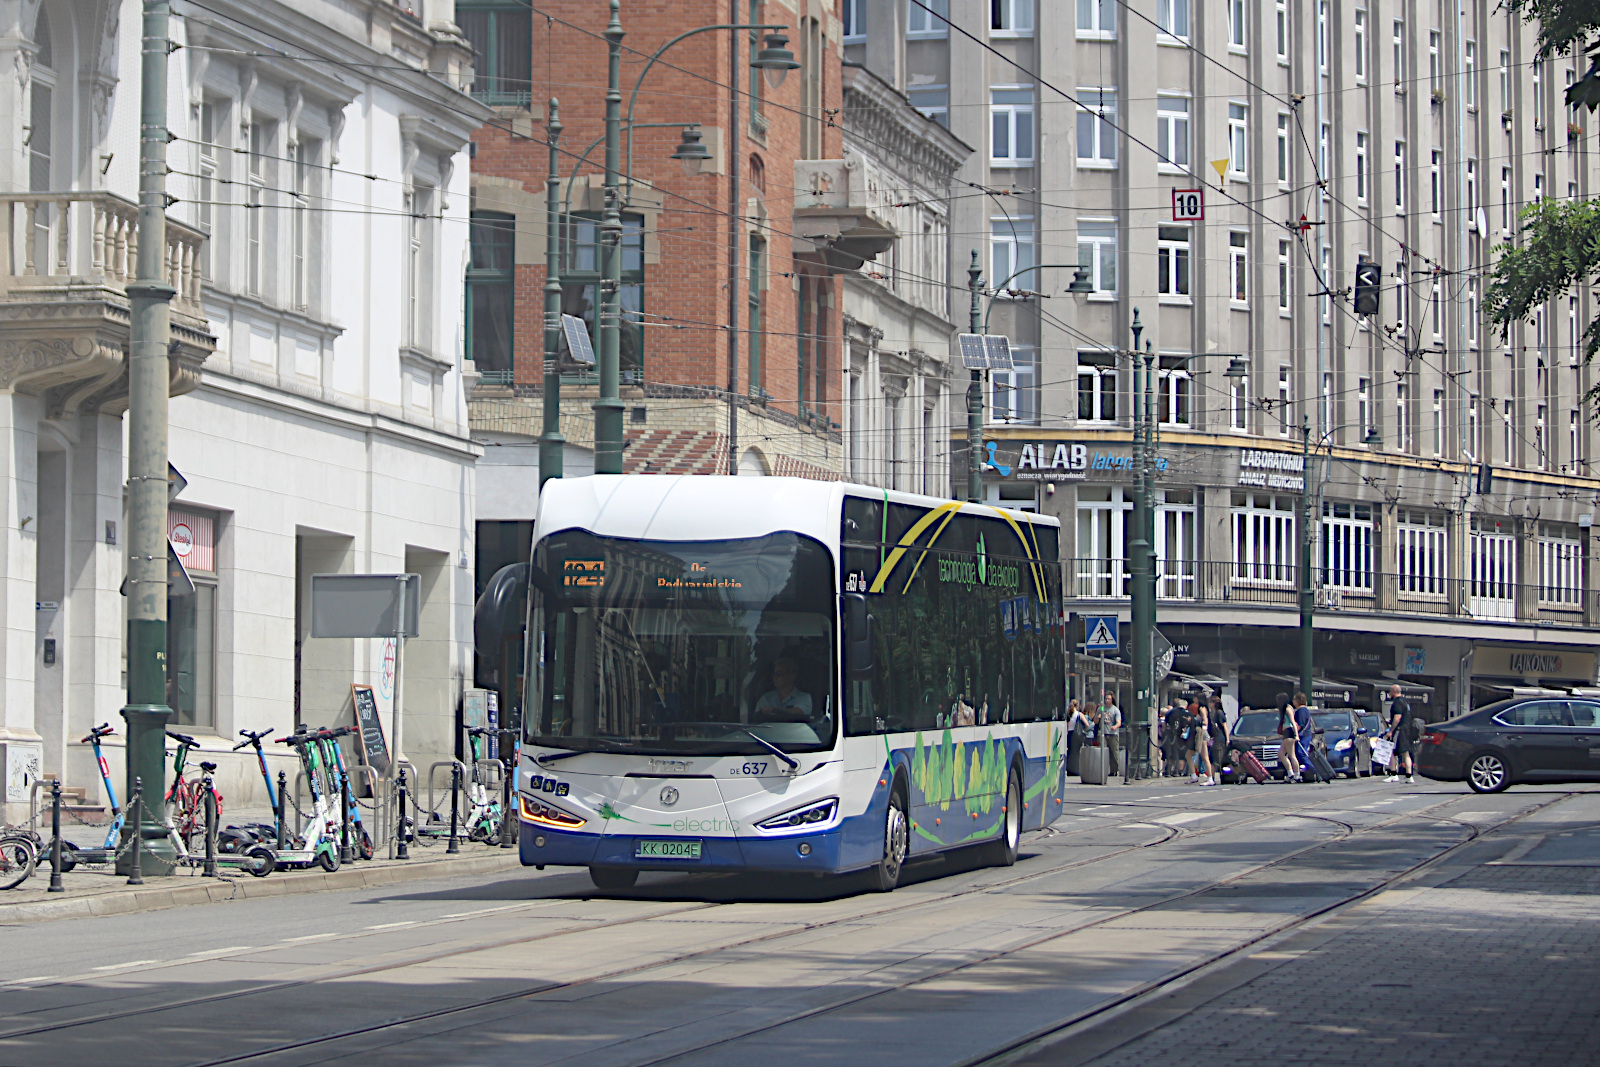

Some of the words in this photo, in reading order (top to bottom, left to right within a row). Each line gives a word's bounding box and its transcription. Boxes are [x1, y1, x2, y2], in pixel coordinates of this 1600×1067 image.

[1177, 194, 1198, 216] 10
[1017, 443, 1088, 470] ALAB
[938, 552, 977, 592] technologia
[1509, 653, 1559, 674] LAJKONIK
[741, 762, 768, 775] 637
[672, 816, 741, 832] electric
[642, 843, 658, 855] KK
[662, 843, 699, 856] 0204E
